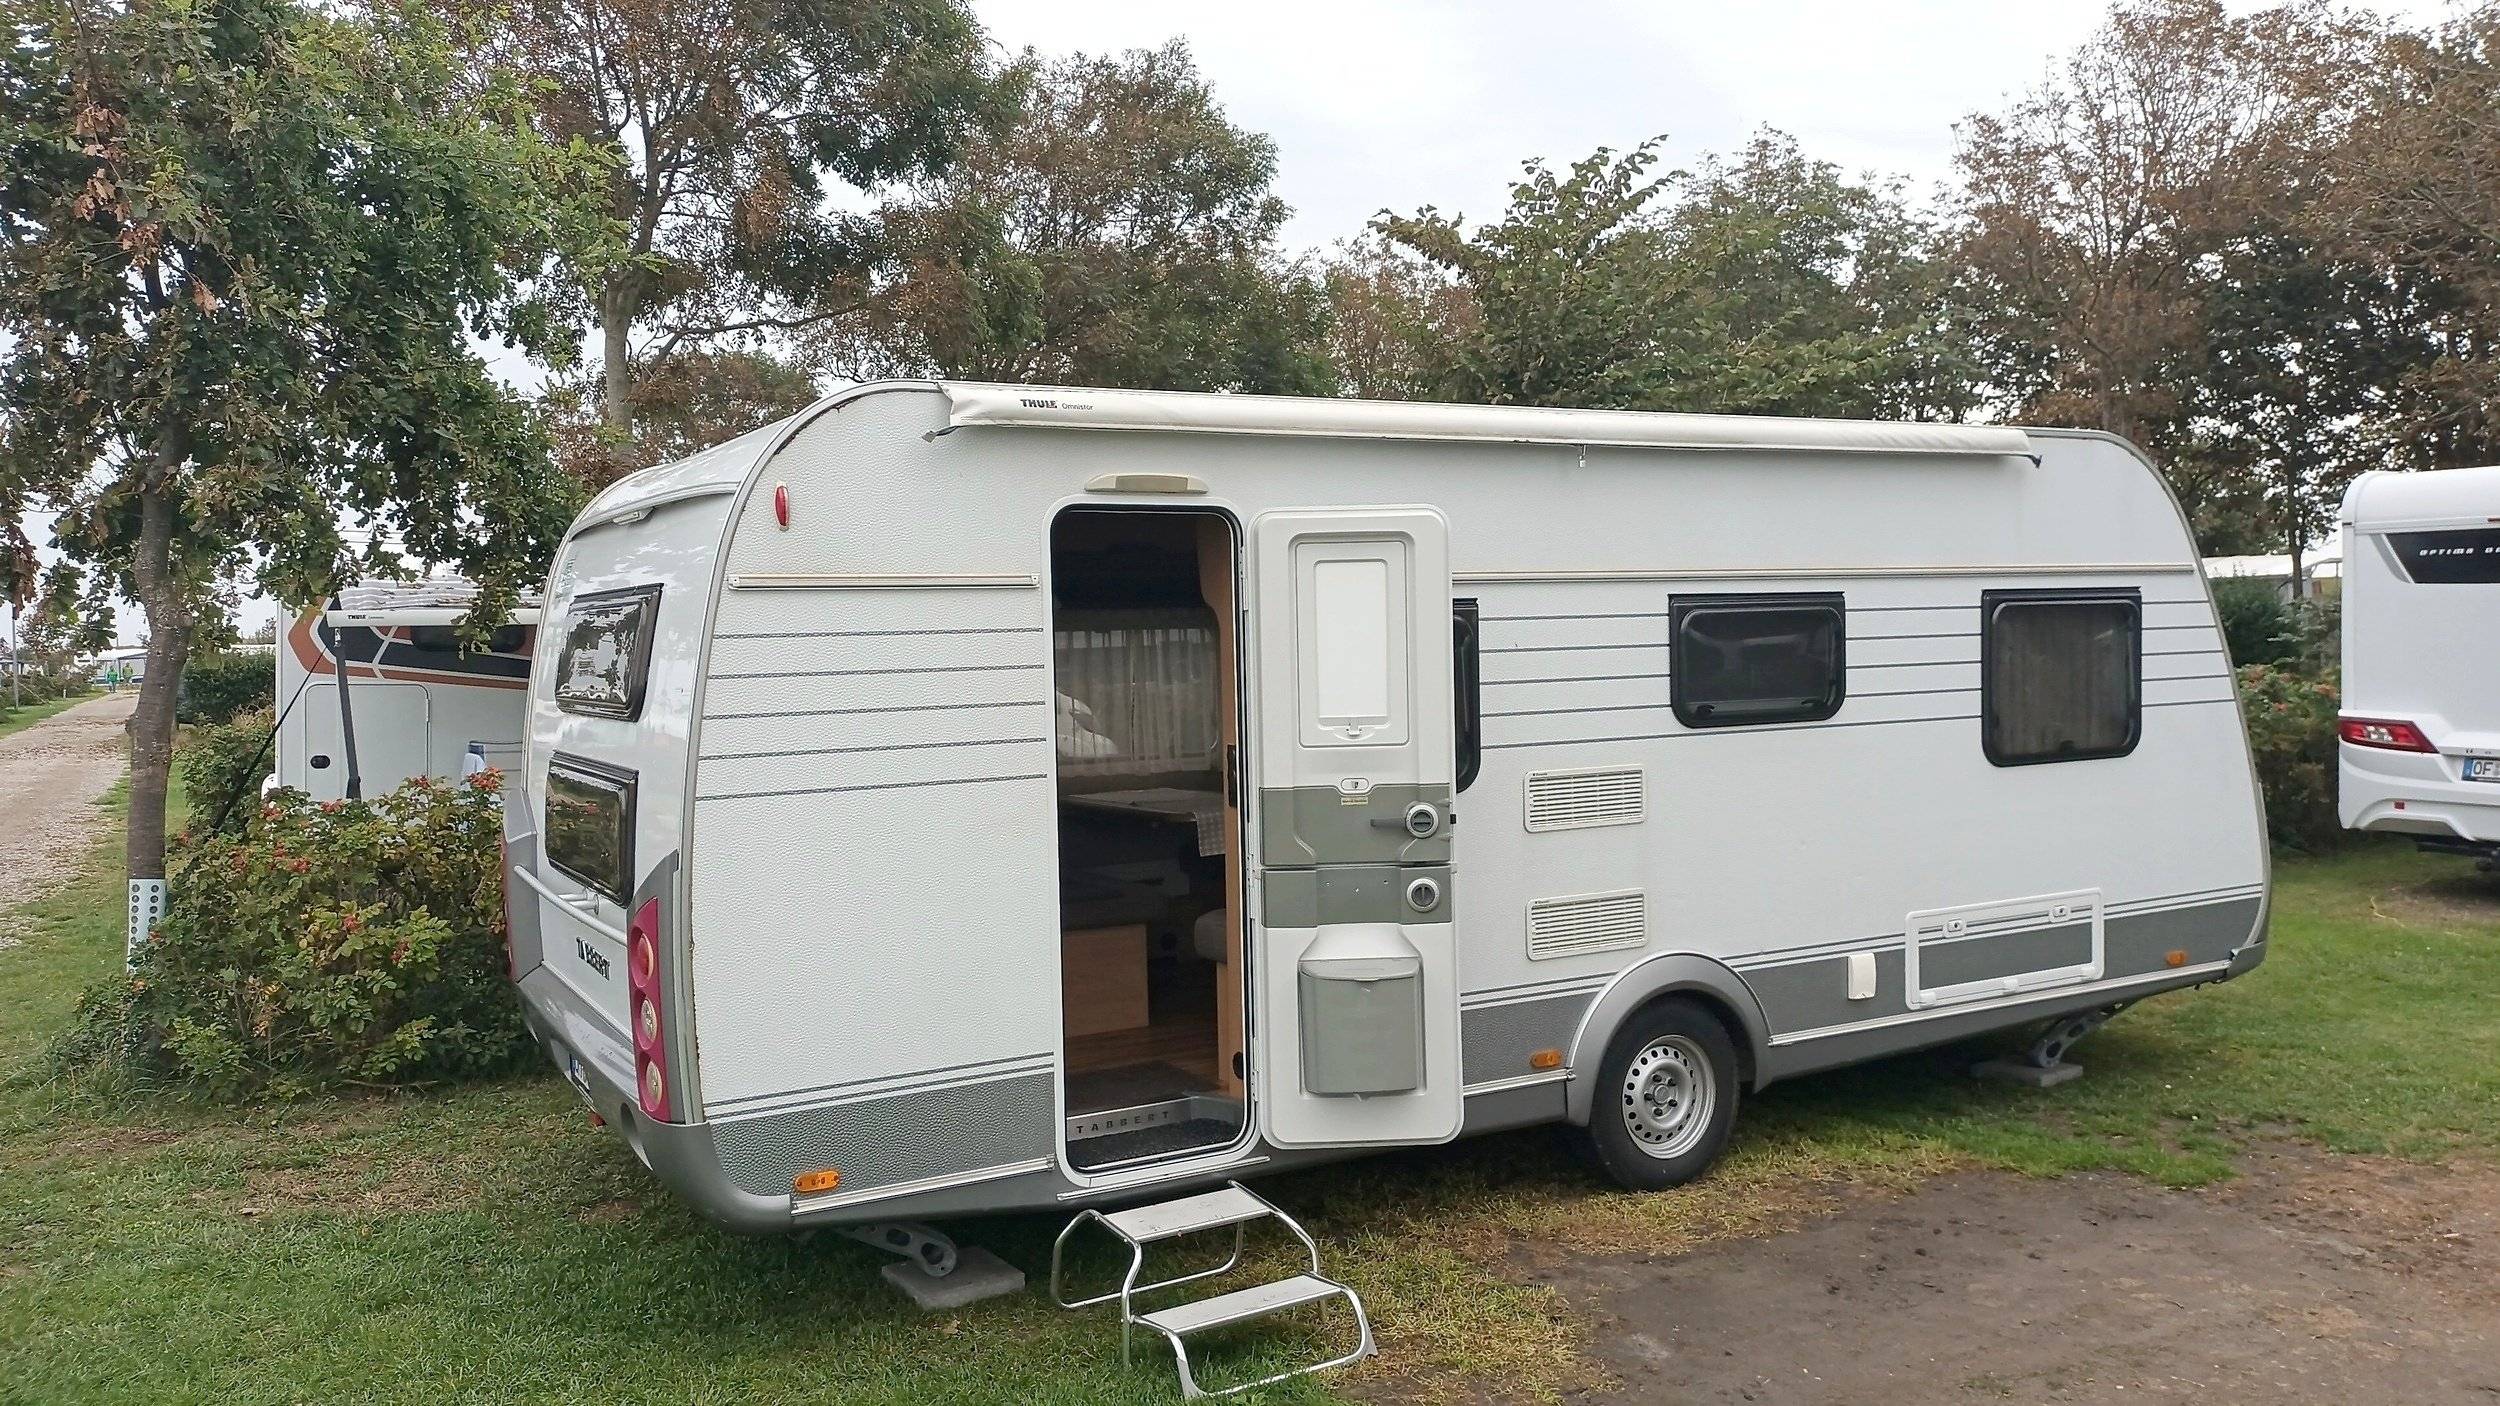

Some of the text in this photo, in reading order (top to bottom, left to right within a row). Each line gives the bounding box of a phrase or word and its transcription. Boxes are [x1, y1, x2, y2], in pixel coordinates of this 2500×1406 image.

[1020, 399, 1057, 408] THULE
[2419, 547, 2474, 556] OPTIMA
[1076, 1111, 1168, 1134] TABBERT
